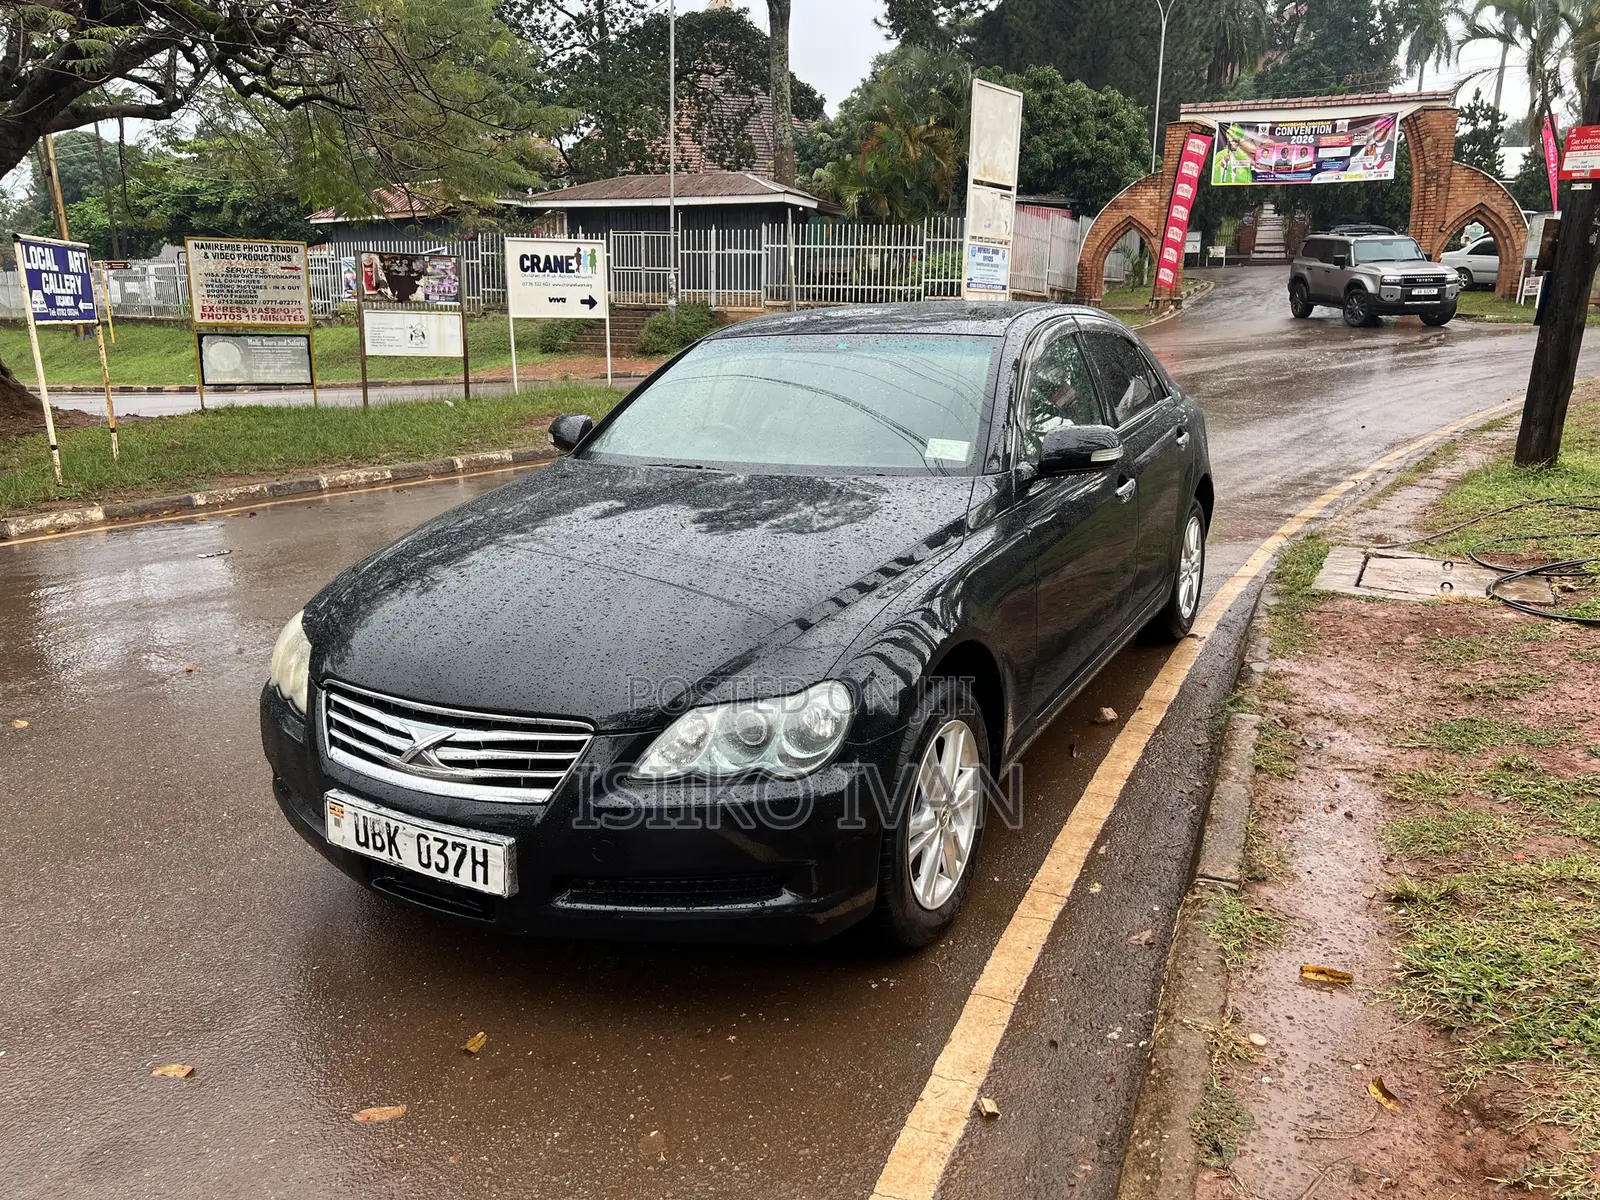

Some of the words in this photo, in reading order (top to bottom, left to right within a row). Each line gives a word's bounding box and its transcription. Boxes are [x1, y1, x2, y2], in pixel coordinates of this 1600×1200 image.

[1275, 124, 1332, 136] CONVENTION
[1290, 135, 1314, 144] 2026
[194, 242, 240, 252] NAMIREMBE
[243, 244, 268, 253] PHOTO
[271, 245, 298, 254] STUDIO
[22, 244, 59, 272] LOCAL
[67, 250, 86, 274] ART
[212, 252, 235, 260] VIDEO
[238, 254, 292, 262] PRODUCTIONS
[519, 254, 575, 273] CRANE
[42, 272, 82, 296] GALLERY
[202, 306, 248, 314] EXPRESS
[354, 812, 403, 860] UBK
[416, 832, 489, 886] 037H
